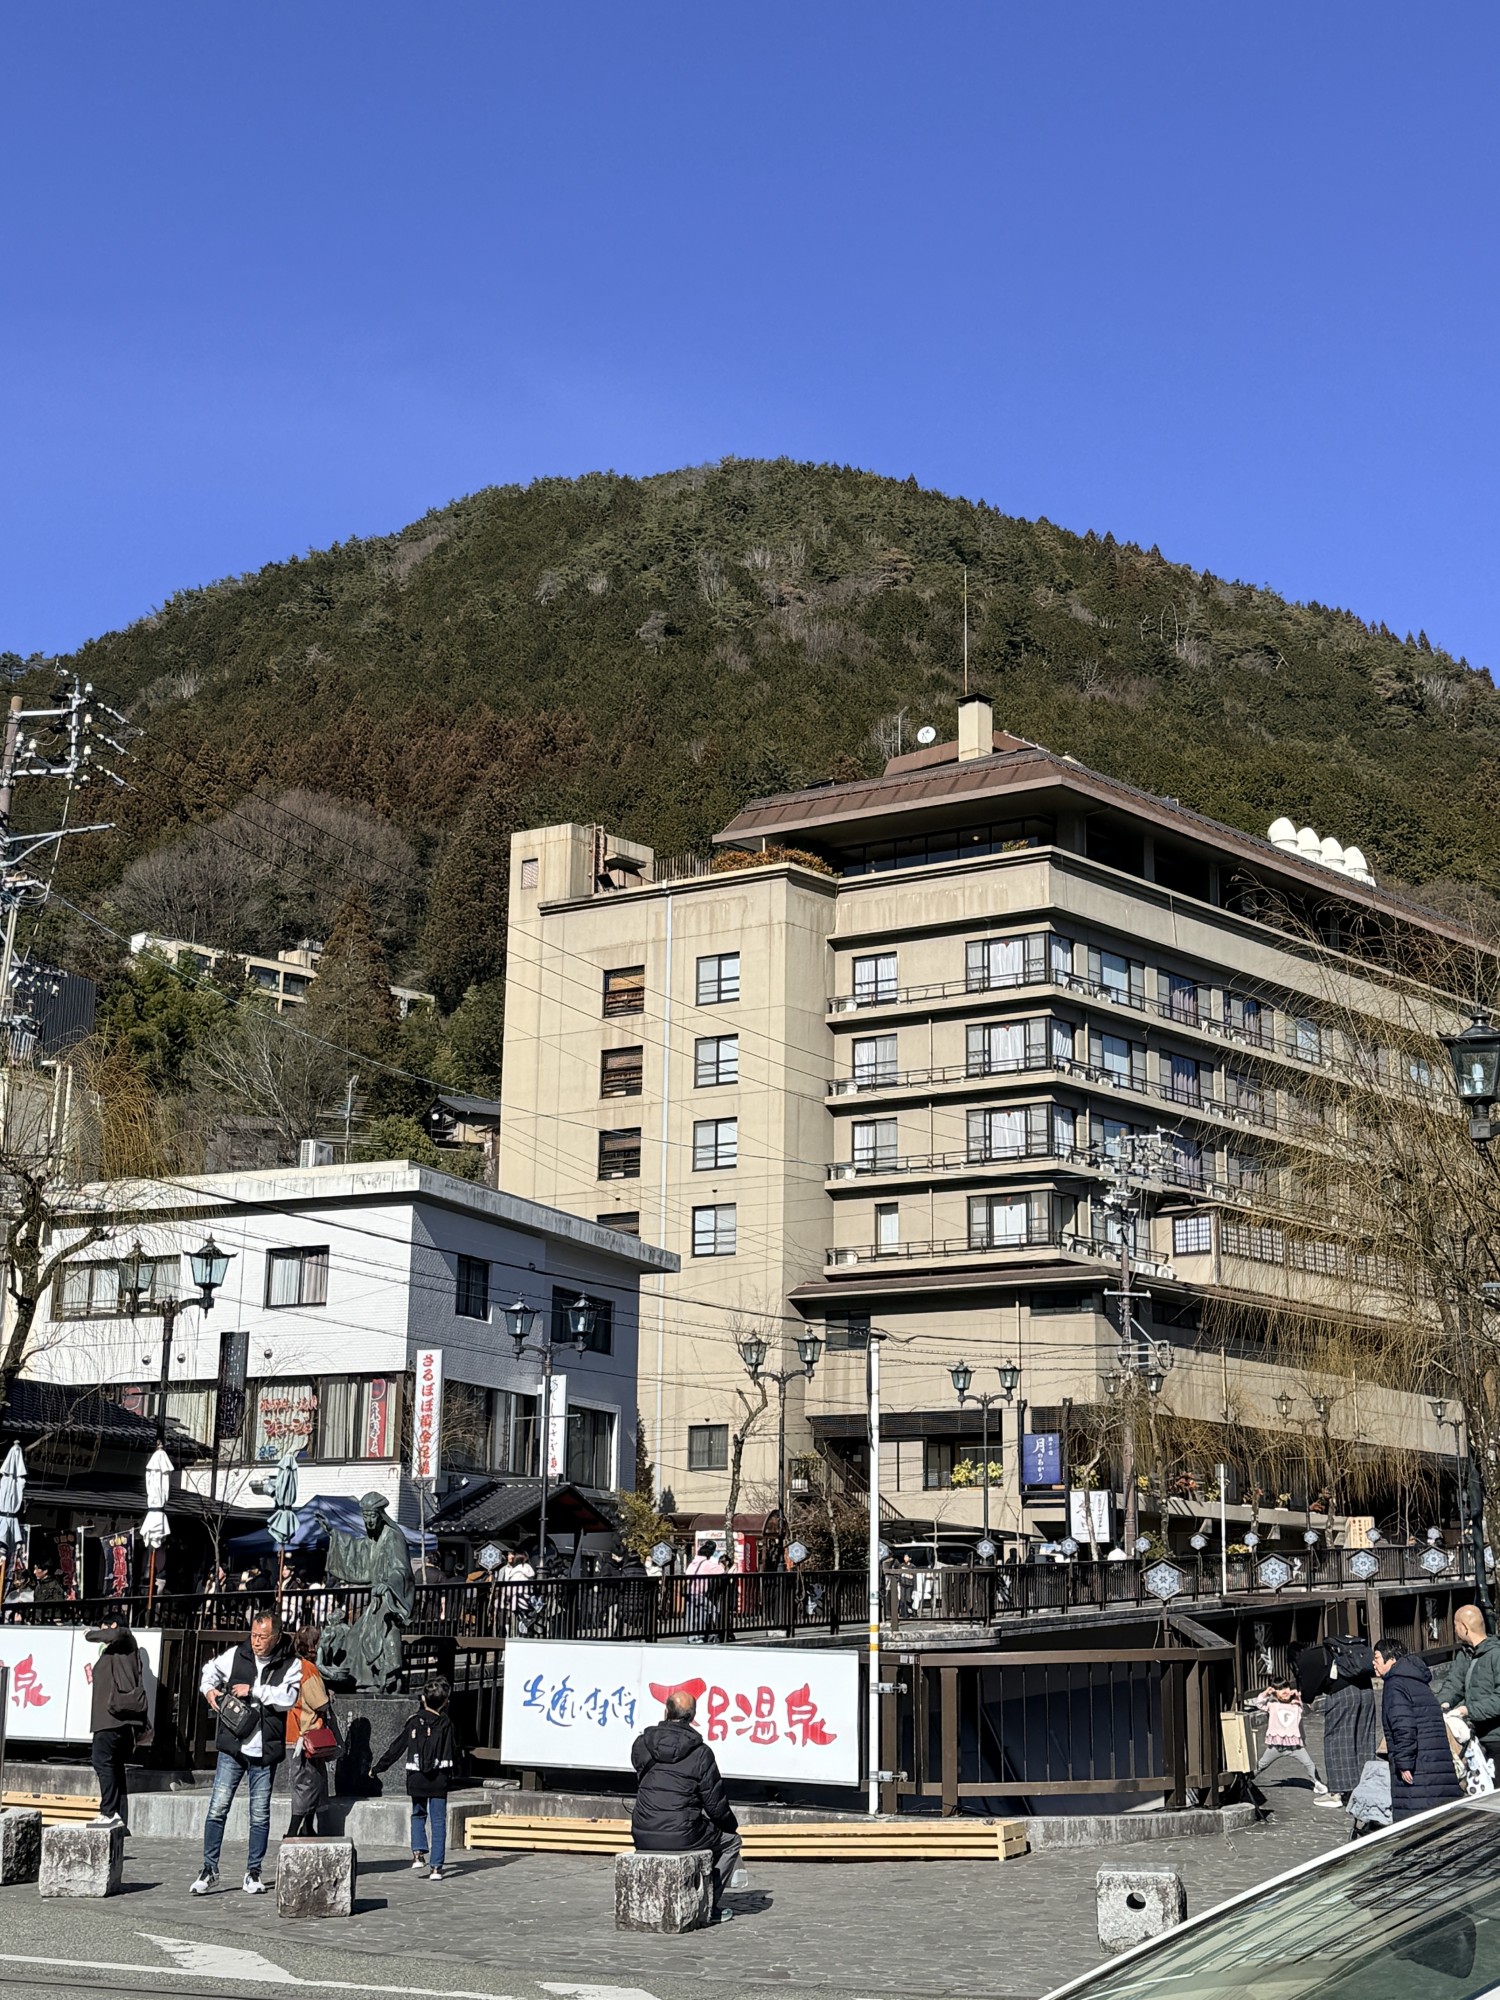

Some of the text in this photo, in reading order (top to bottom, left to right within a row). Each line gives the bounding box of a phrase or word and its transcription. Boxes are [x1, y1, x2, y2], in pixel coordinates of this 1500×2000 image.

[1032, 1438, 1045, 1482] 月のあかり
[0, 1653, 51, 1709] 泉
